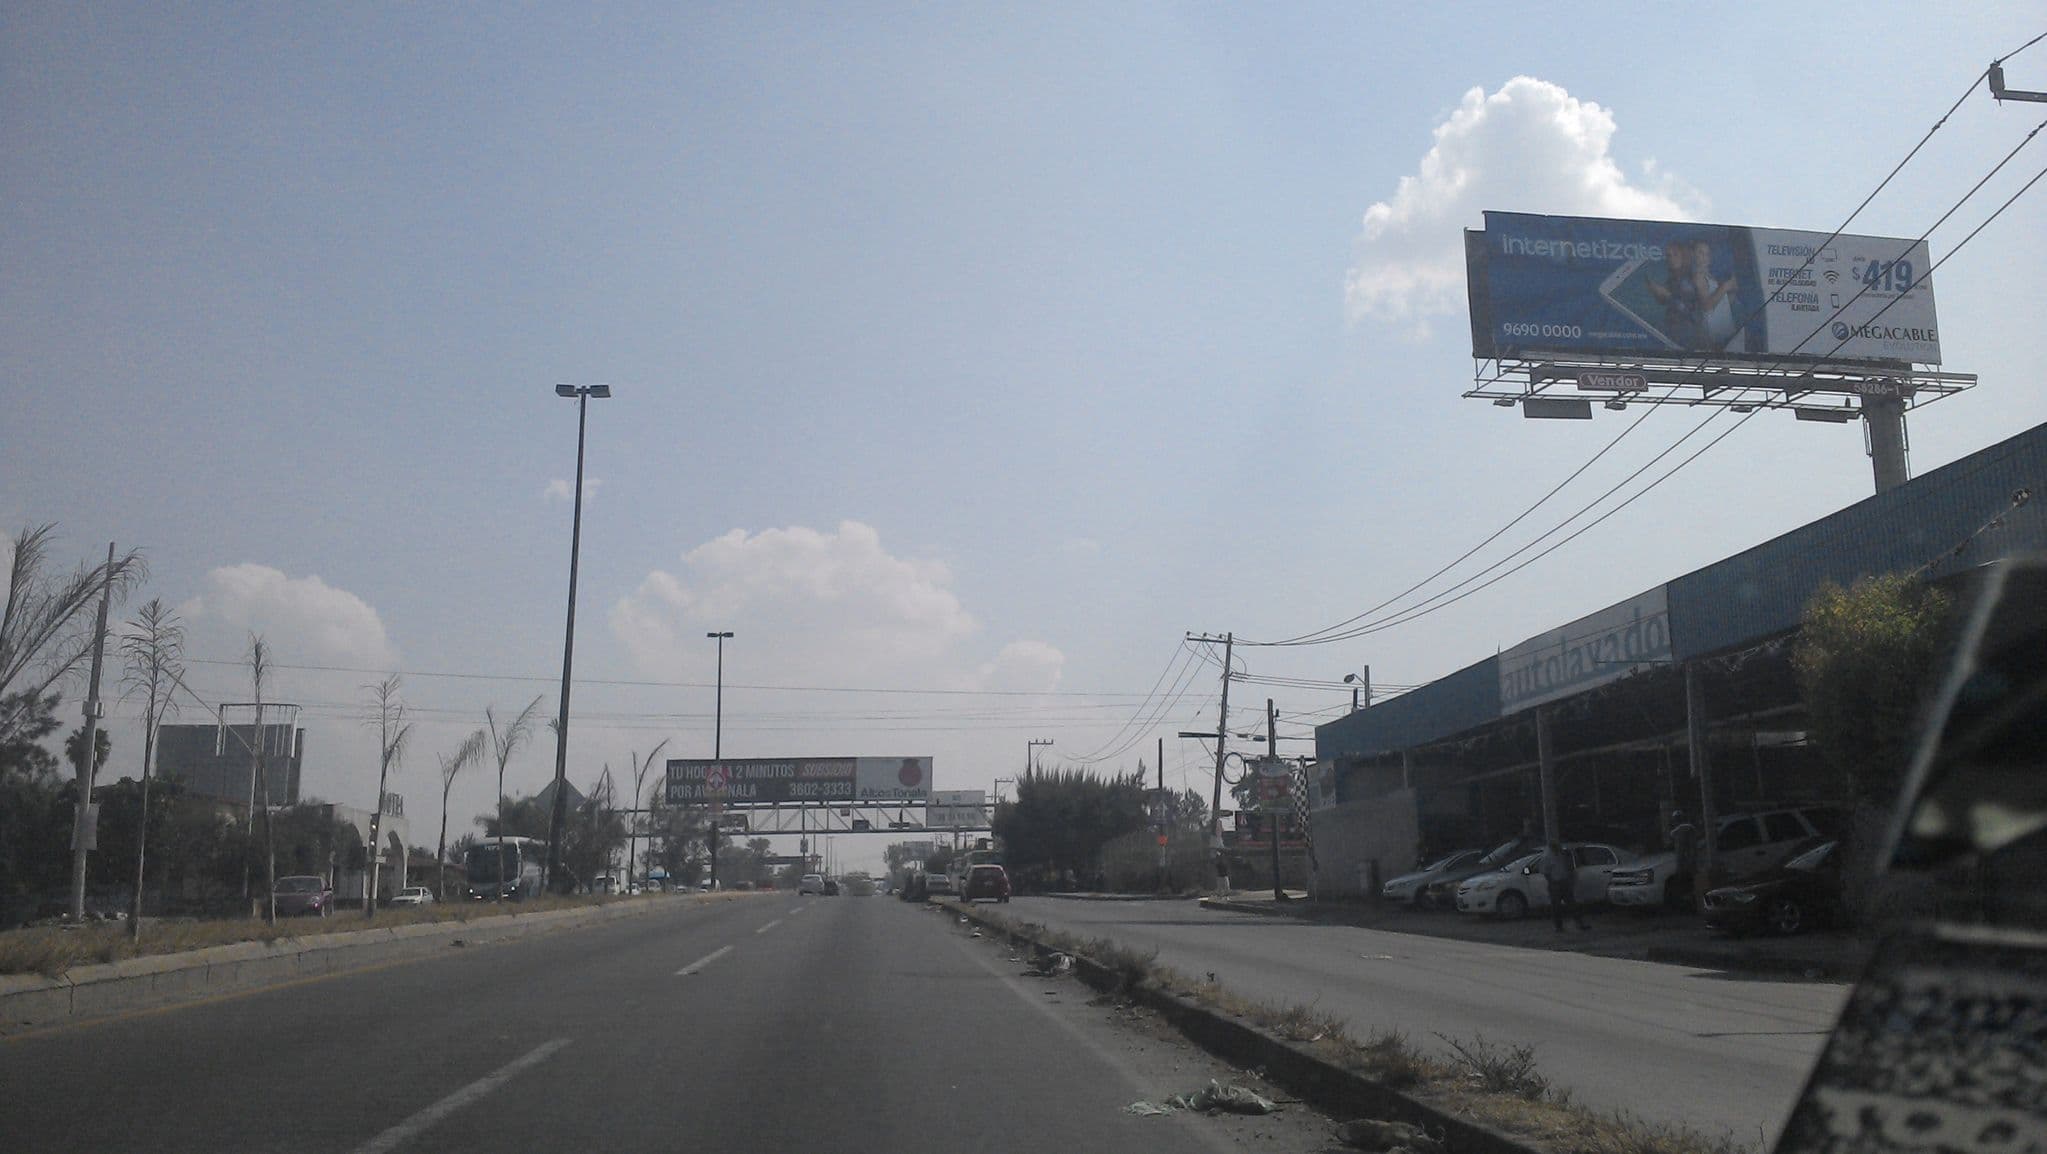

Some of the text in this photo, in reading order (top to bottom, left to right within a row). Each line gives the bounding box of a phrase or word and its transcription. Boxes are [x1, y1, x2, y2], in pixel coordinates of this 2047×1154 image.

[1769, 267, 1813, 280] INTERNET
[1503, 322, 1581, 339] 9690 0000
[1850, 324, 1937, 343] MEGACABLE
[1587, 375, 1638, 387] Vendor
[1503, 607, 1664, 698] autolavado
[670, 766, 683, 779] TU
[735, 765, 743, 777] 2
[745, 764, 795, 778] MINUTOS
[670, 785, 692, 800] POR
